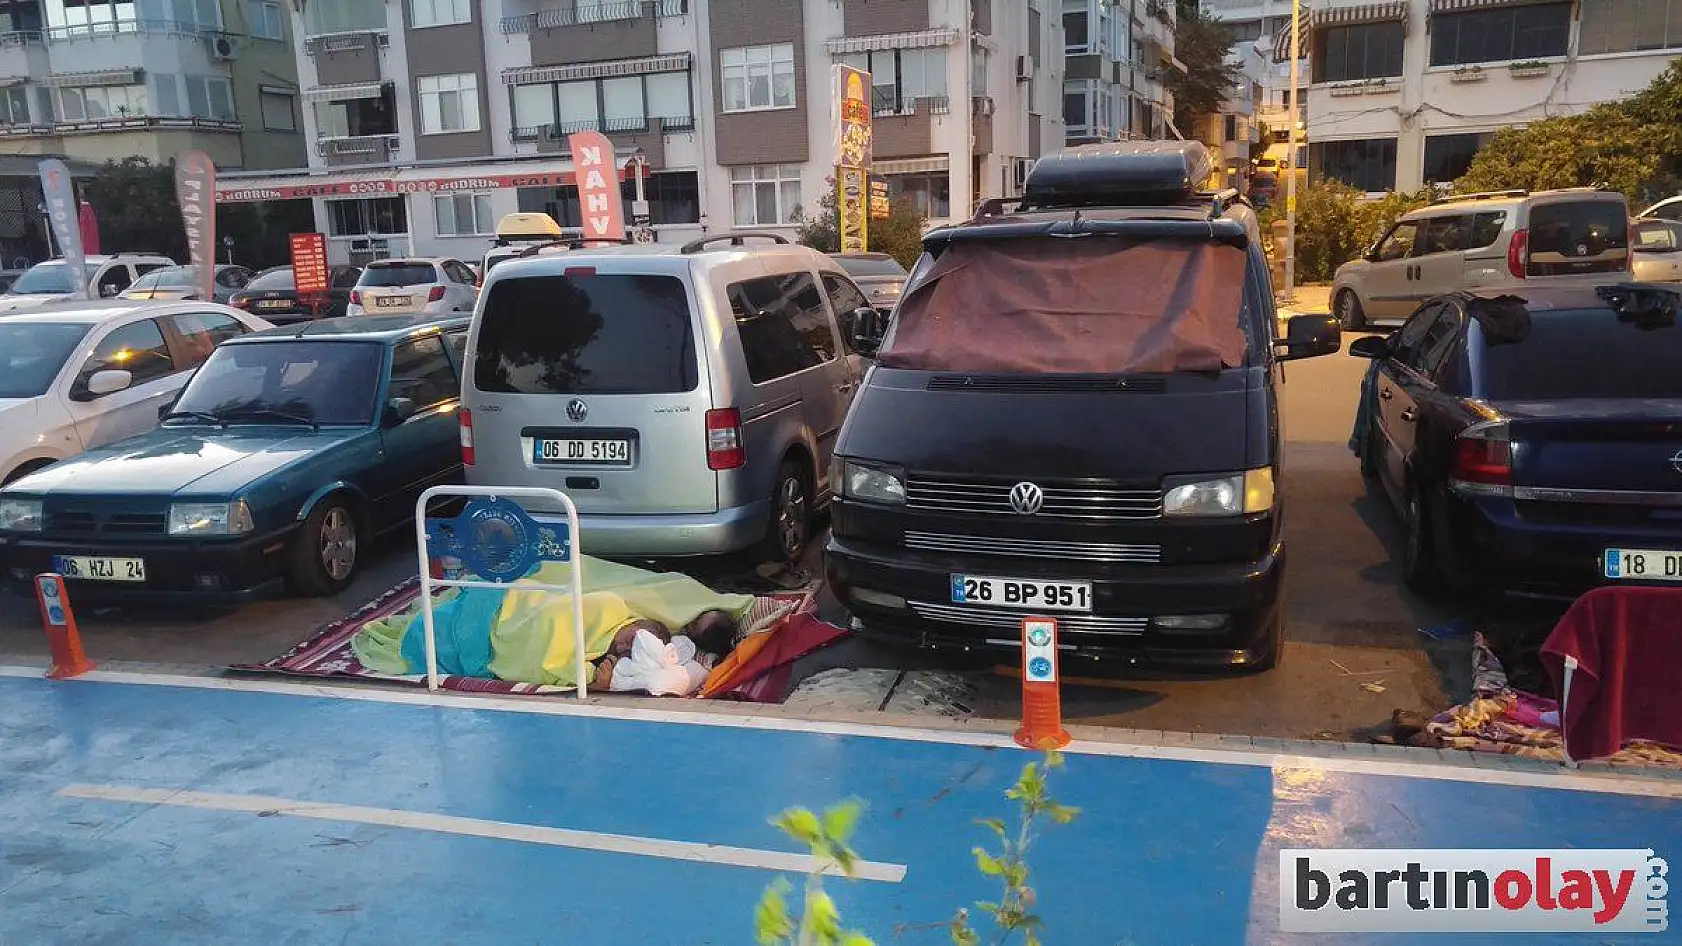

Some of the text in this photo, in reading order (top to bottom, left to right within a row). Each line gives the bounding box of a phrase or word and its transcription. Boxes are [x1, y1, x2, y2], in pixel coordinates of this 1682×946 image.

[544, 441, 626, 459] 06 DD 5194
[63, 559, 143, 578] 06 HZJ 24
[1624, 554, 1645, 574] 18
[965, 579, 992, 600] 26
[1005, 582, 1038, 604] BP
[1043, 585, 1086, 608] 951
